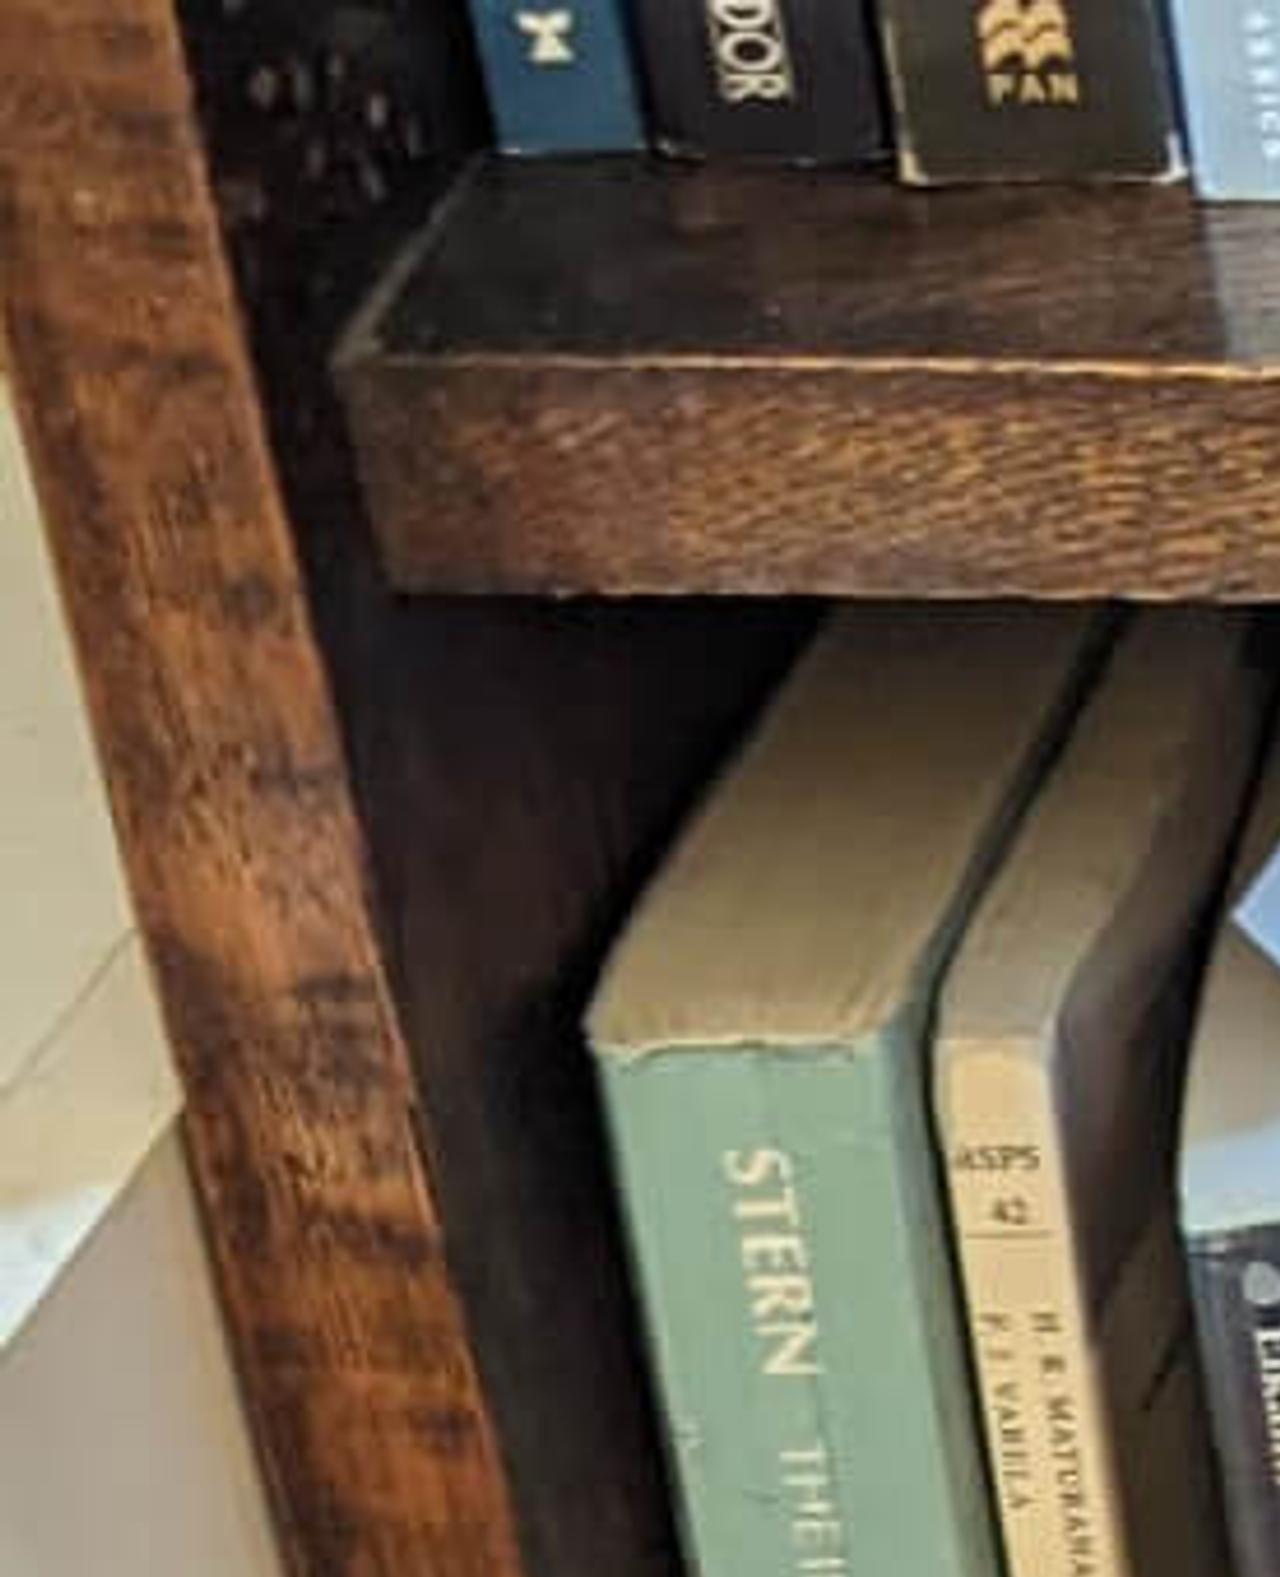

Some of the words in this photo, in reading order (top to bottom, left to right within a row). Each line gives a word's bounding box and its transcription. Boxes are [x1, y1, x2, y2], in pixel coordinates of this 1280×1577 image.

[986, 72, 1080, 104] PAN
[722, 1146, 820, 1378] STERN
[776, 1440, 848, 1546] THE
